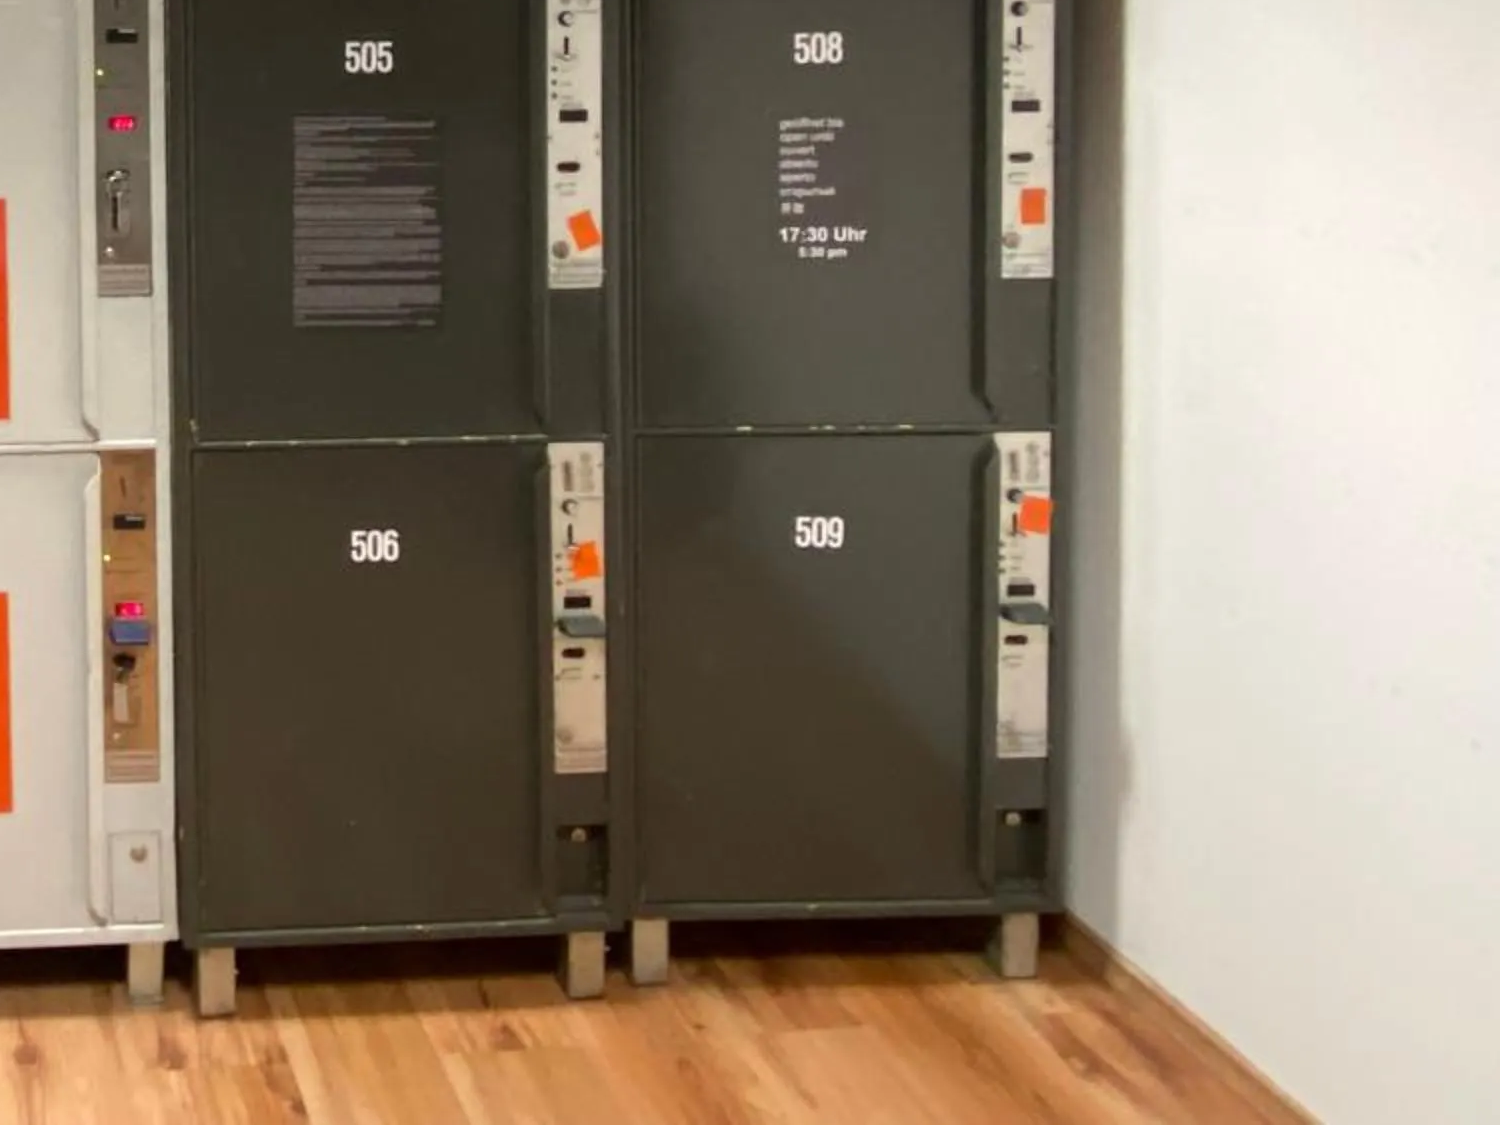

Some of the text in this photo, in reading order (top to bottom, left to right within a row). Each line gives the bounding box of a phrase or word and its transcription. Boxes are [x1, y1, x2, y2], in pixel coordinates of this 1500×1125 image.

[344, 40, 394, 74] 505
[793, 32, 844, 64] 508
[780, 226, 867, 243] 17:30 Uhr
[350, 529, 400, 563] 506
[794, 515, 845, 549] 509
